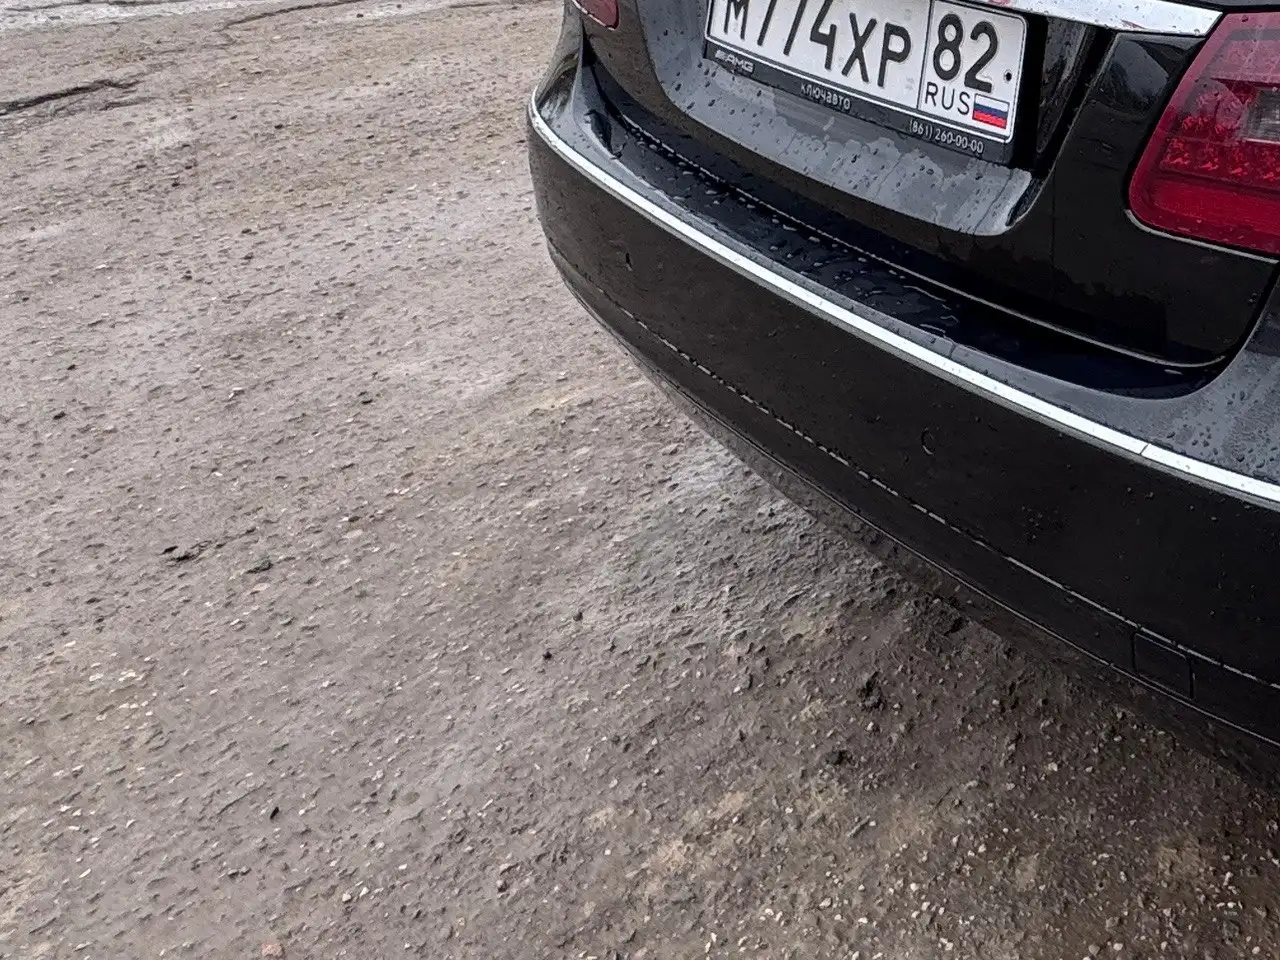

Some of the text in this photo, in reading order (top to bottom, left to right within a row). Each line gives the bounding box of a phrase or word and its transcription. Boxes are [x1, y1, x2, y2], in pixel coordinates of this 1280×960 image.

[932, 13, 999, 93] 82
[924, 81, 971, 116] RUS
[934, 127, 984, 154] 260-00-00
